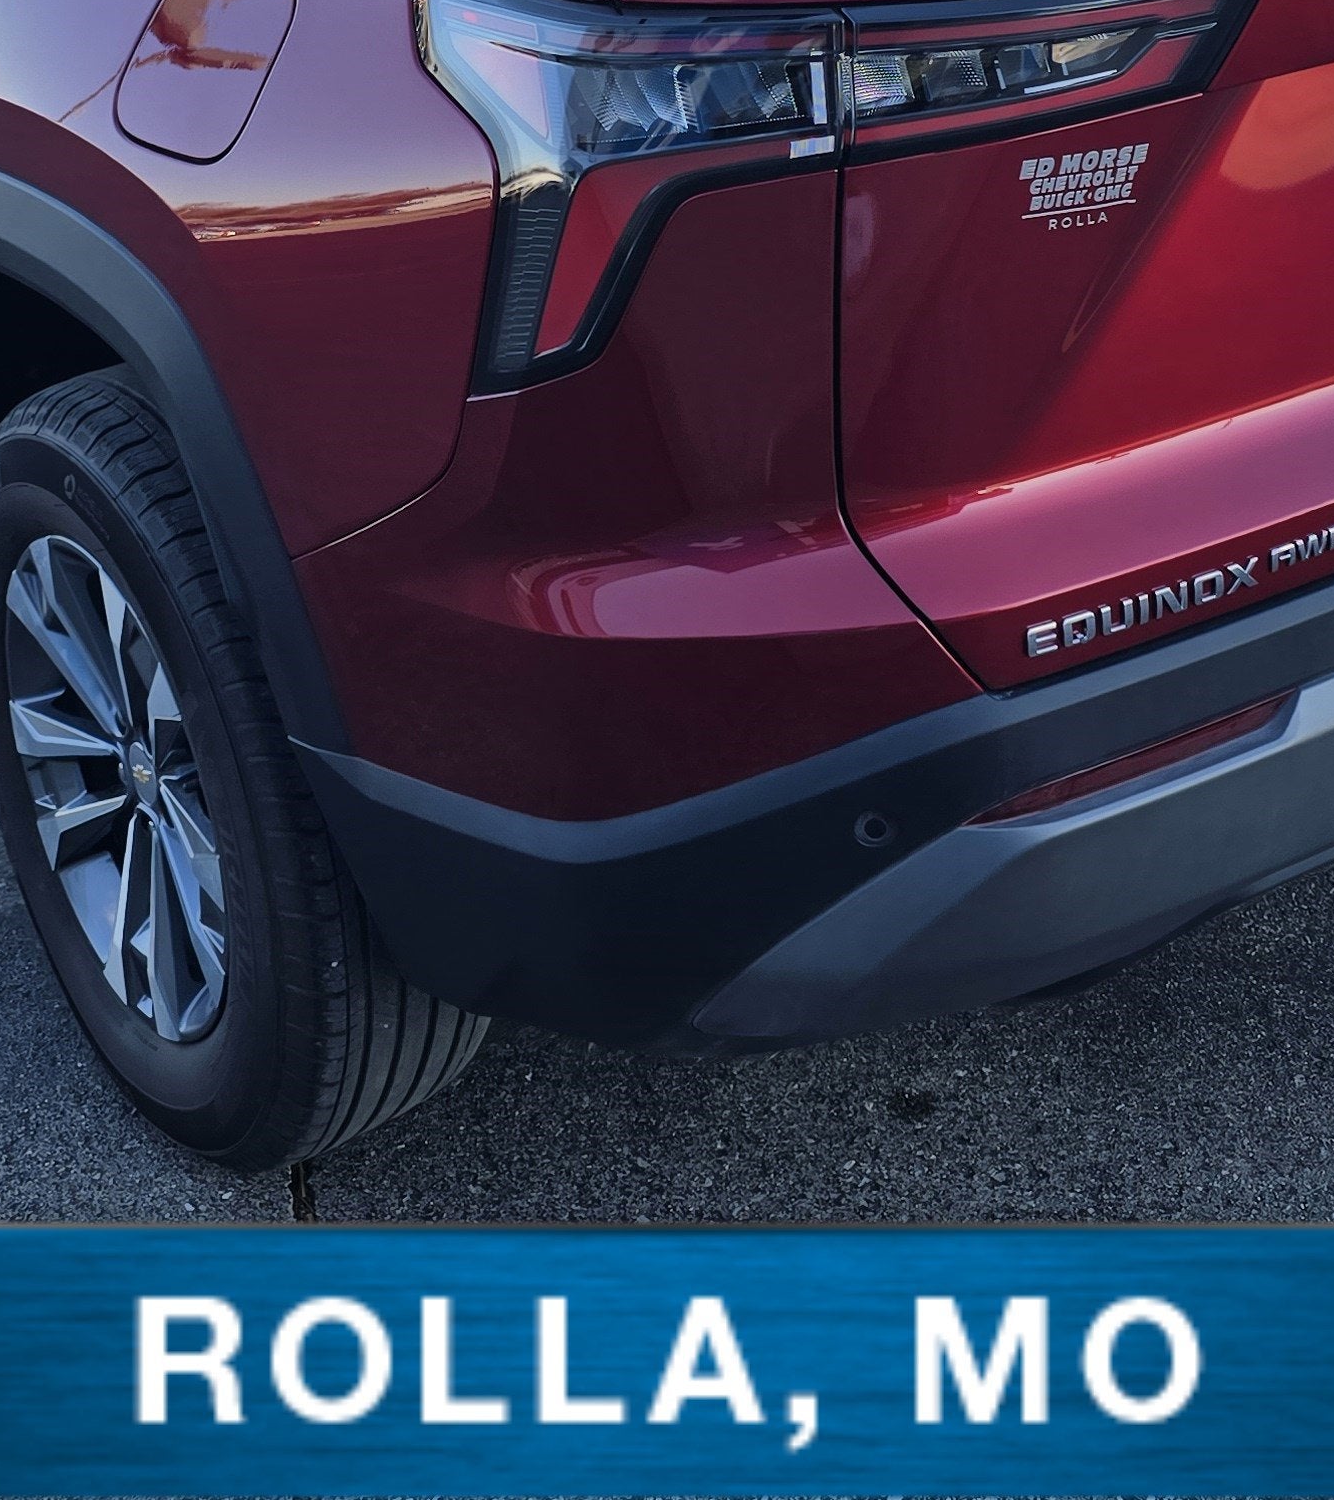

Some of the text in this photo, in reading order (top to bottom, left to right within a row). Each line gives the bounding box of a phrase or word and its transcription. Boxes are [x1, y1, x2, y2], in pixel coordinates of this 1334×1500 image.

[1019, 143, 1149, 180] ED MORSE
[1029, 165, 1138, 195] CHEVROLET
[1048, 211, 1109, 231] ROLLA
[1026, 554, 1260, 658] EQUINOX
